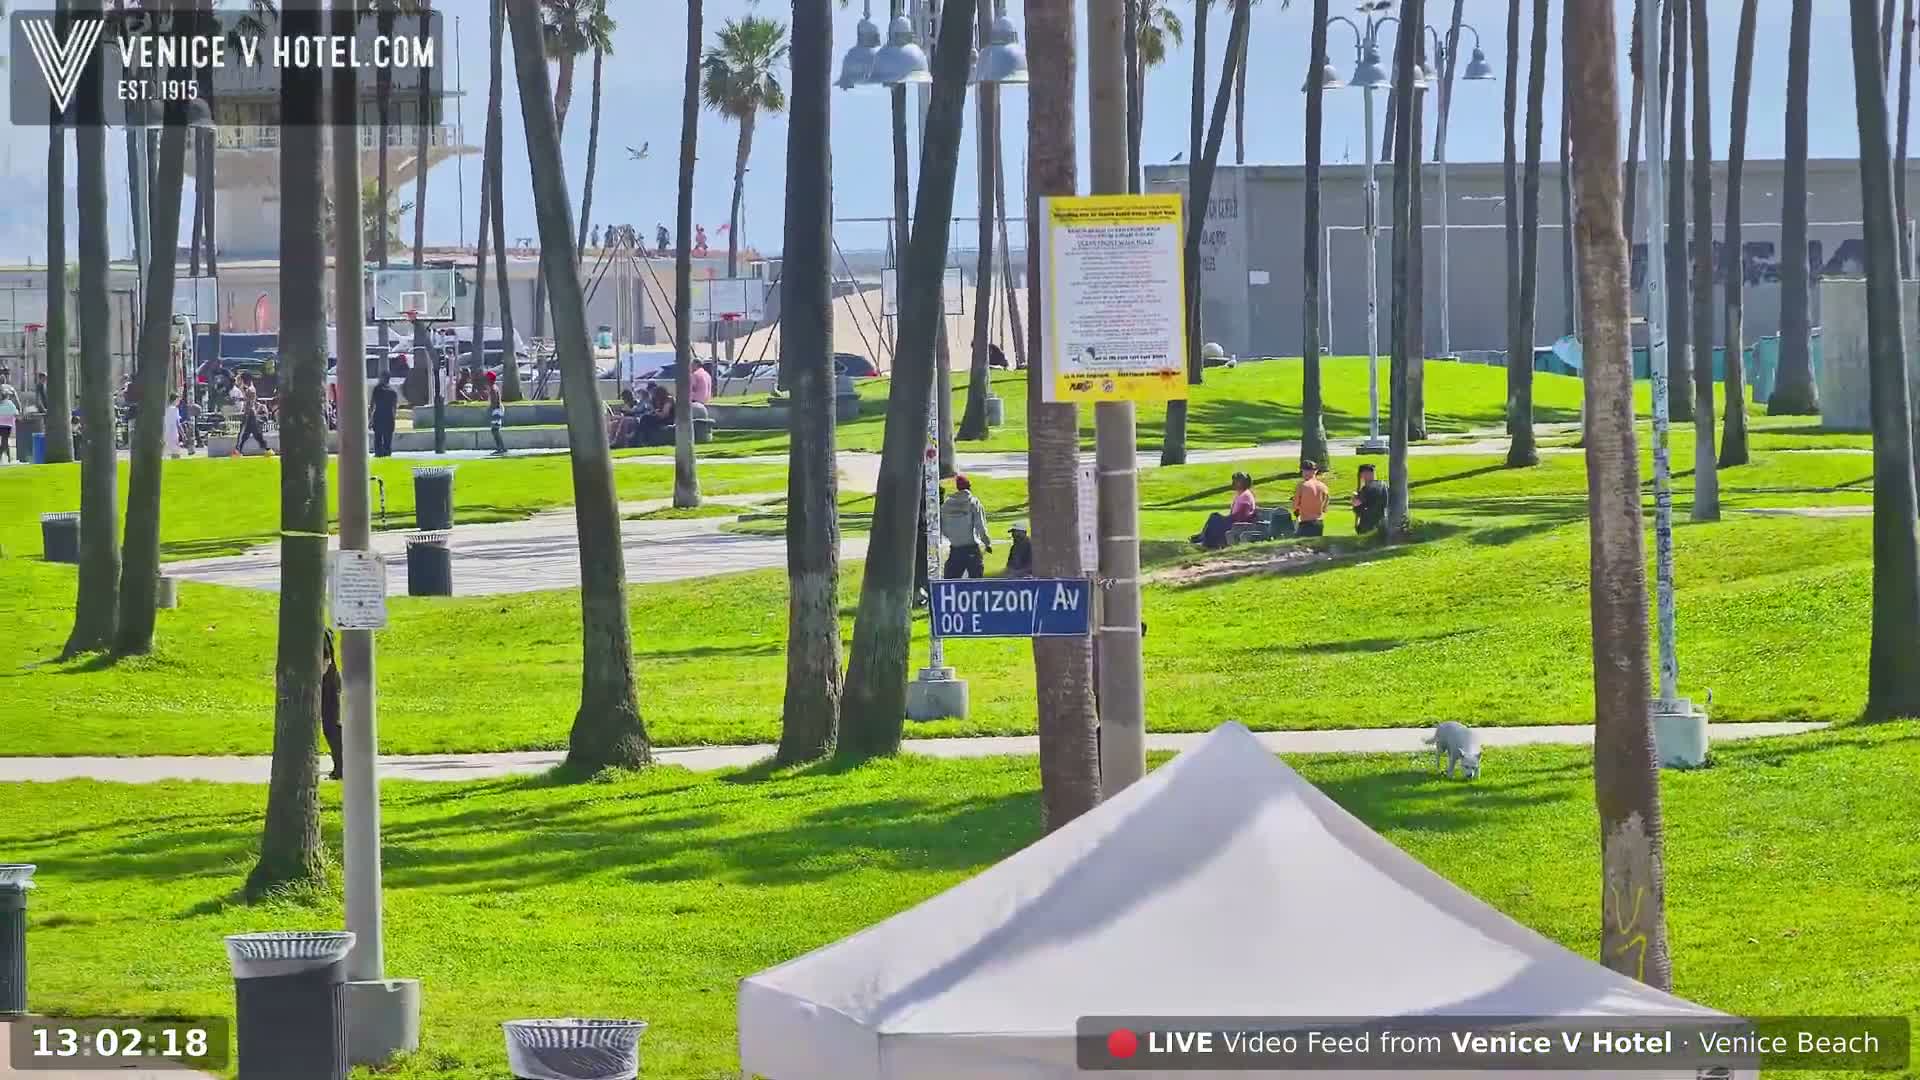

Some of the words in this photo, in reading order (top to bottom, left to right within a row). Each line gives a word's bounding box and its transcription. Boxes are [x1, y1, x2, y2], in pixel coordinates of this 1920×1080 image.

[940, 583, 1032, 613] Horizon
[1052, 583, 1080, 612] Av
[941, 613, 964, 633] 00
[972, 613, 983, 633] E
